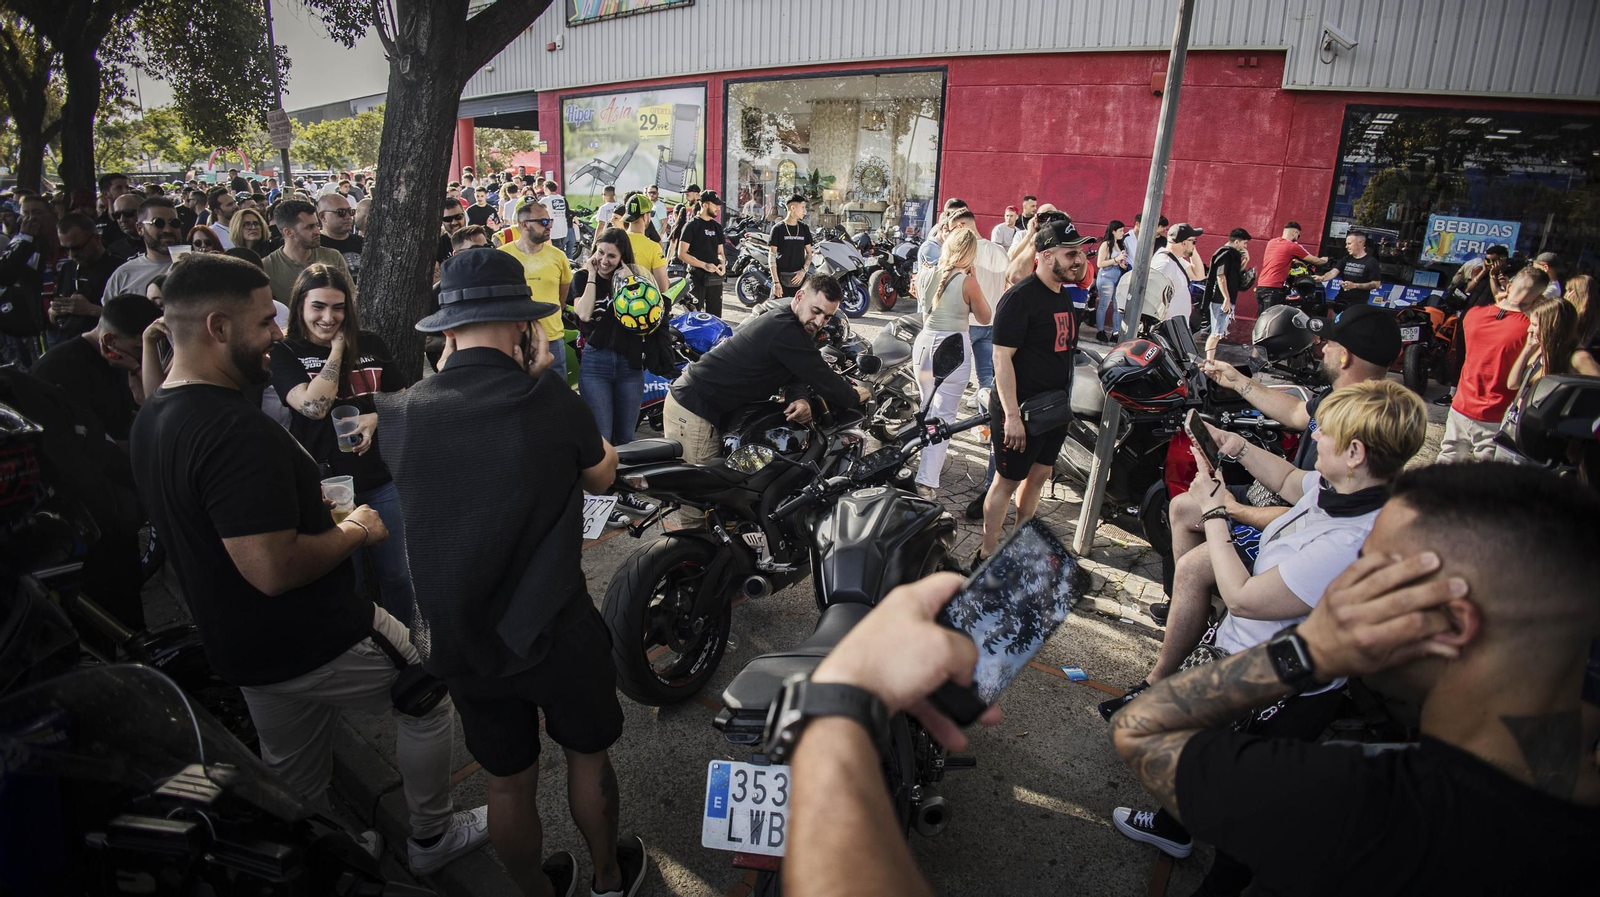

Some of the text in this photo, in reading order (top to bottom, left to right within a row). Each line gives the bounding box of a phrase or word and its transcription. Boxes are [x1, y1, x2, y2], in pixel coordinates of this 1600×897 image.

[566, 97, 632, 127] Hiper Asia
[1433, 219, 1513, 238] BEBIDAS
[1456, 239, 1510, 255] FRI
[732, 769, 789, 807] 353
[713, 796, 723, 809] E
[727, 807, 786, 848] LWB
